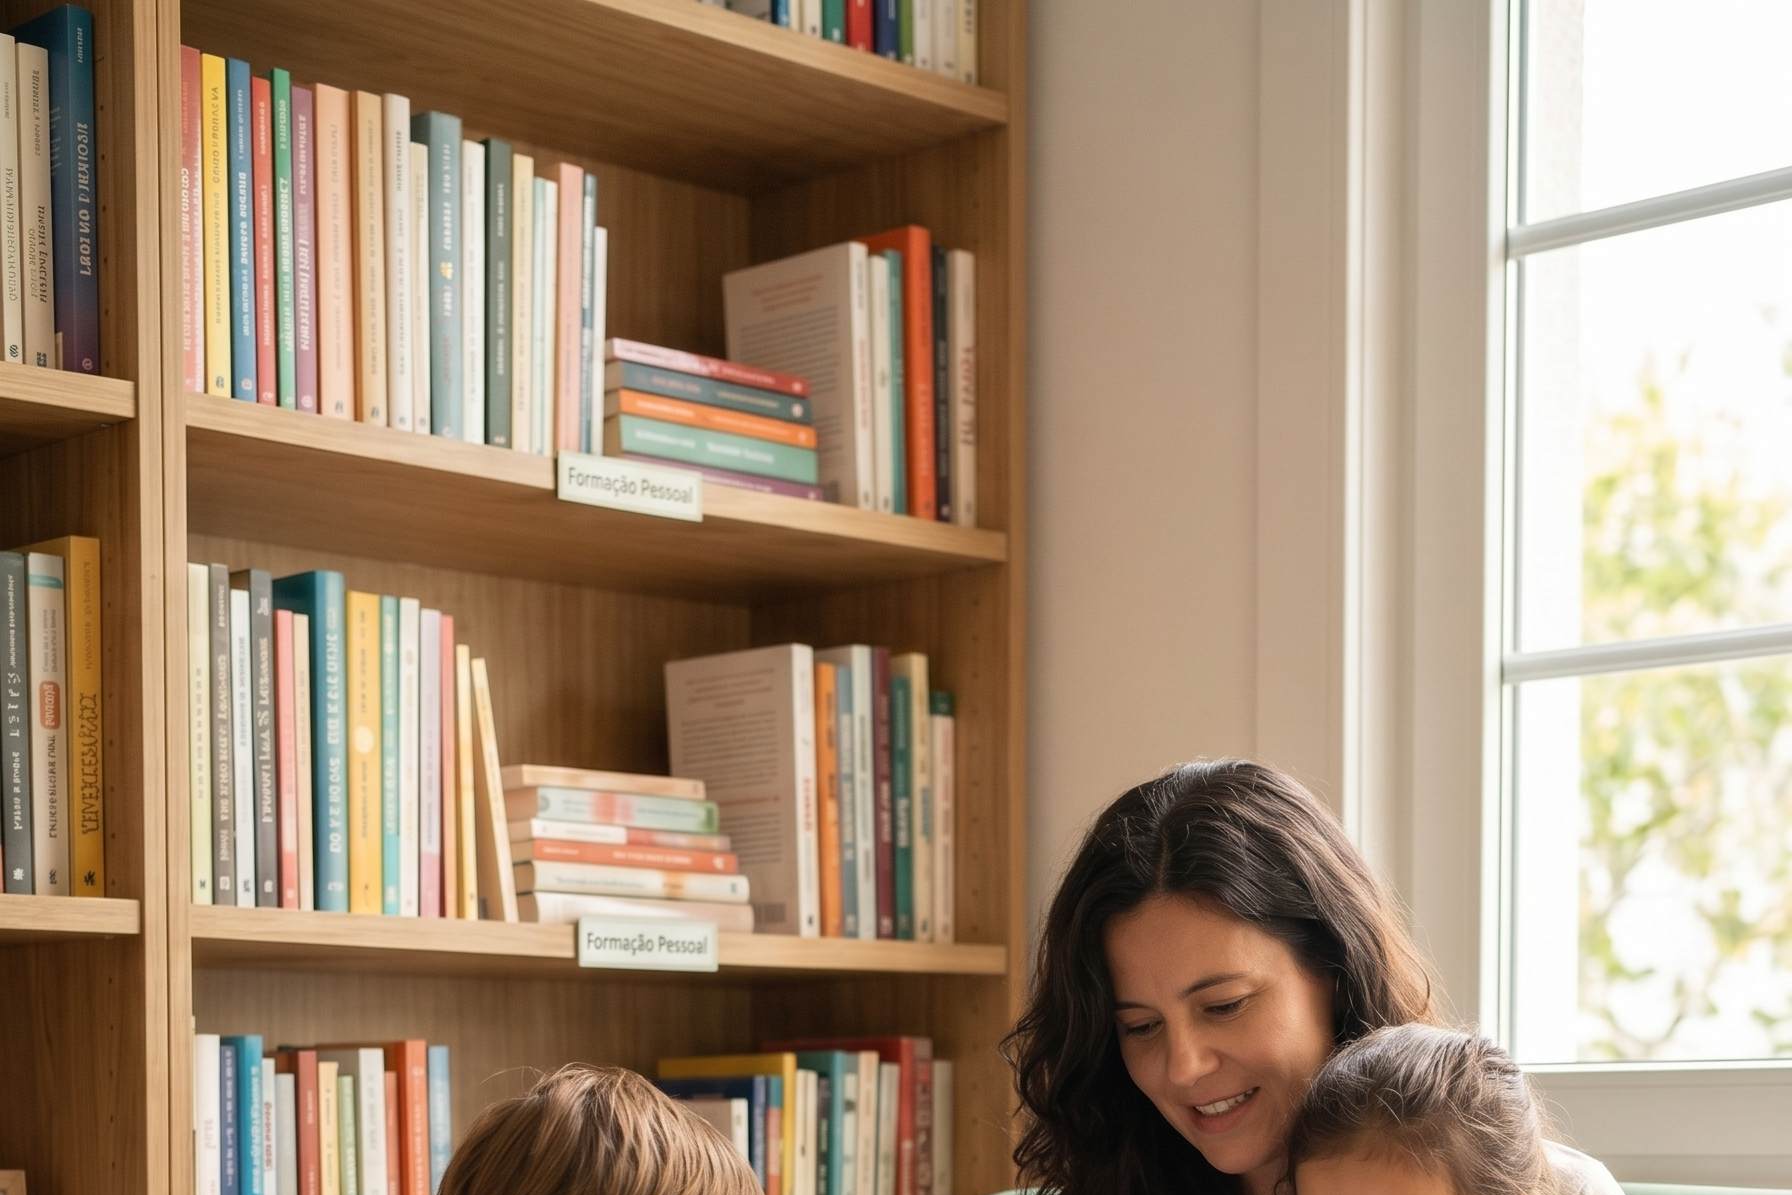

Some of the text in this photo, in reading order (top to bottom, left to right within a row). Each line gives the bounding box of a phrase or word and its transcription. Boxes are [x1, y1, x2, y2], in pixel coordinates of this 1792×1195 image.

[568, 467, 693, 504] Formação Pessoal
[587, 932, 708, 955] Formação Pessoal
